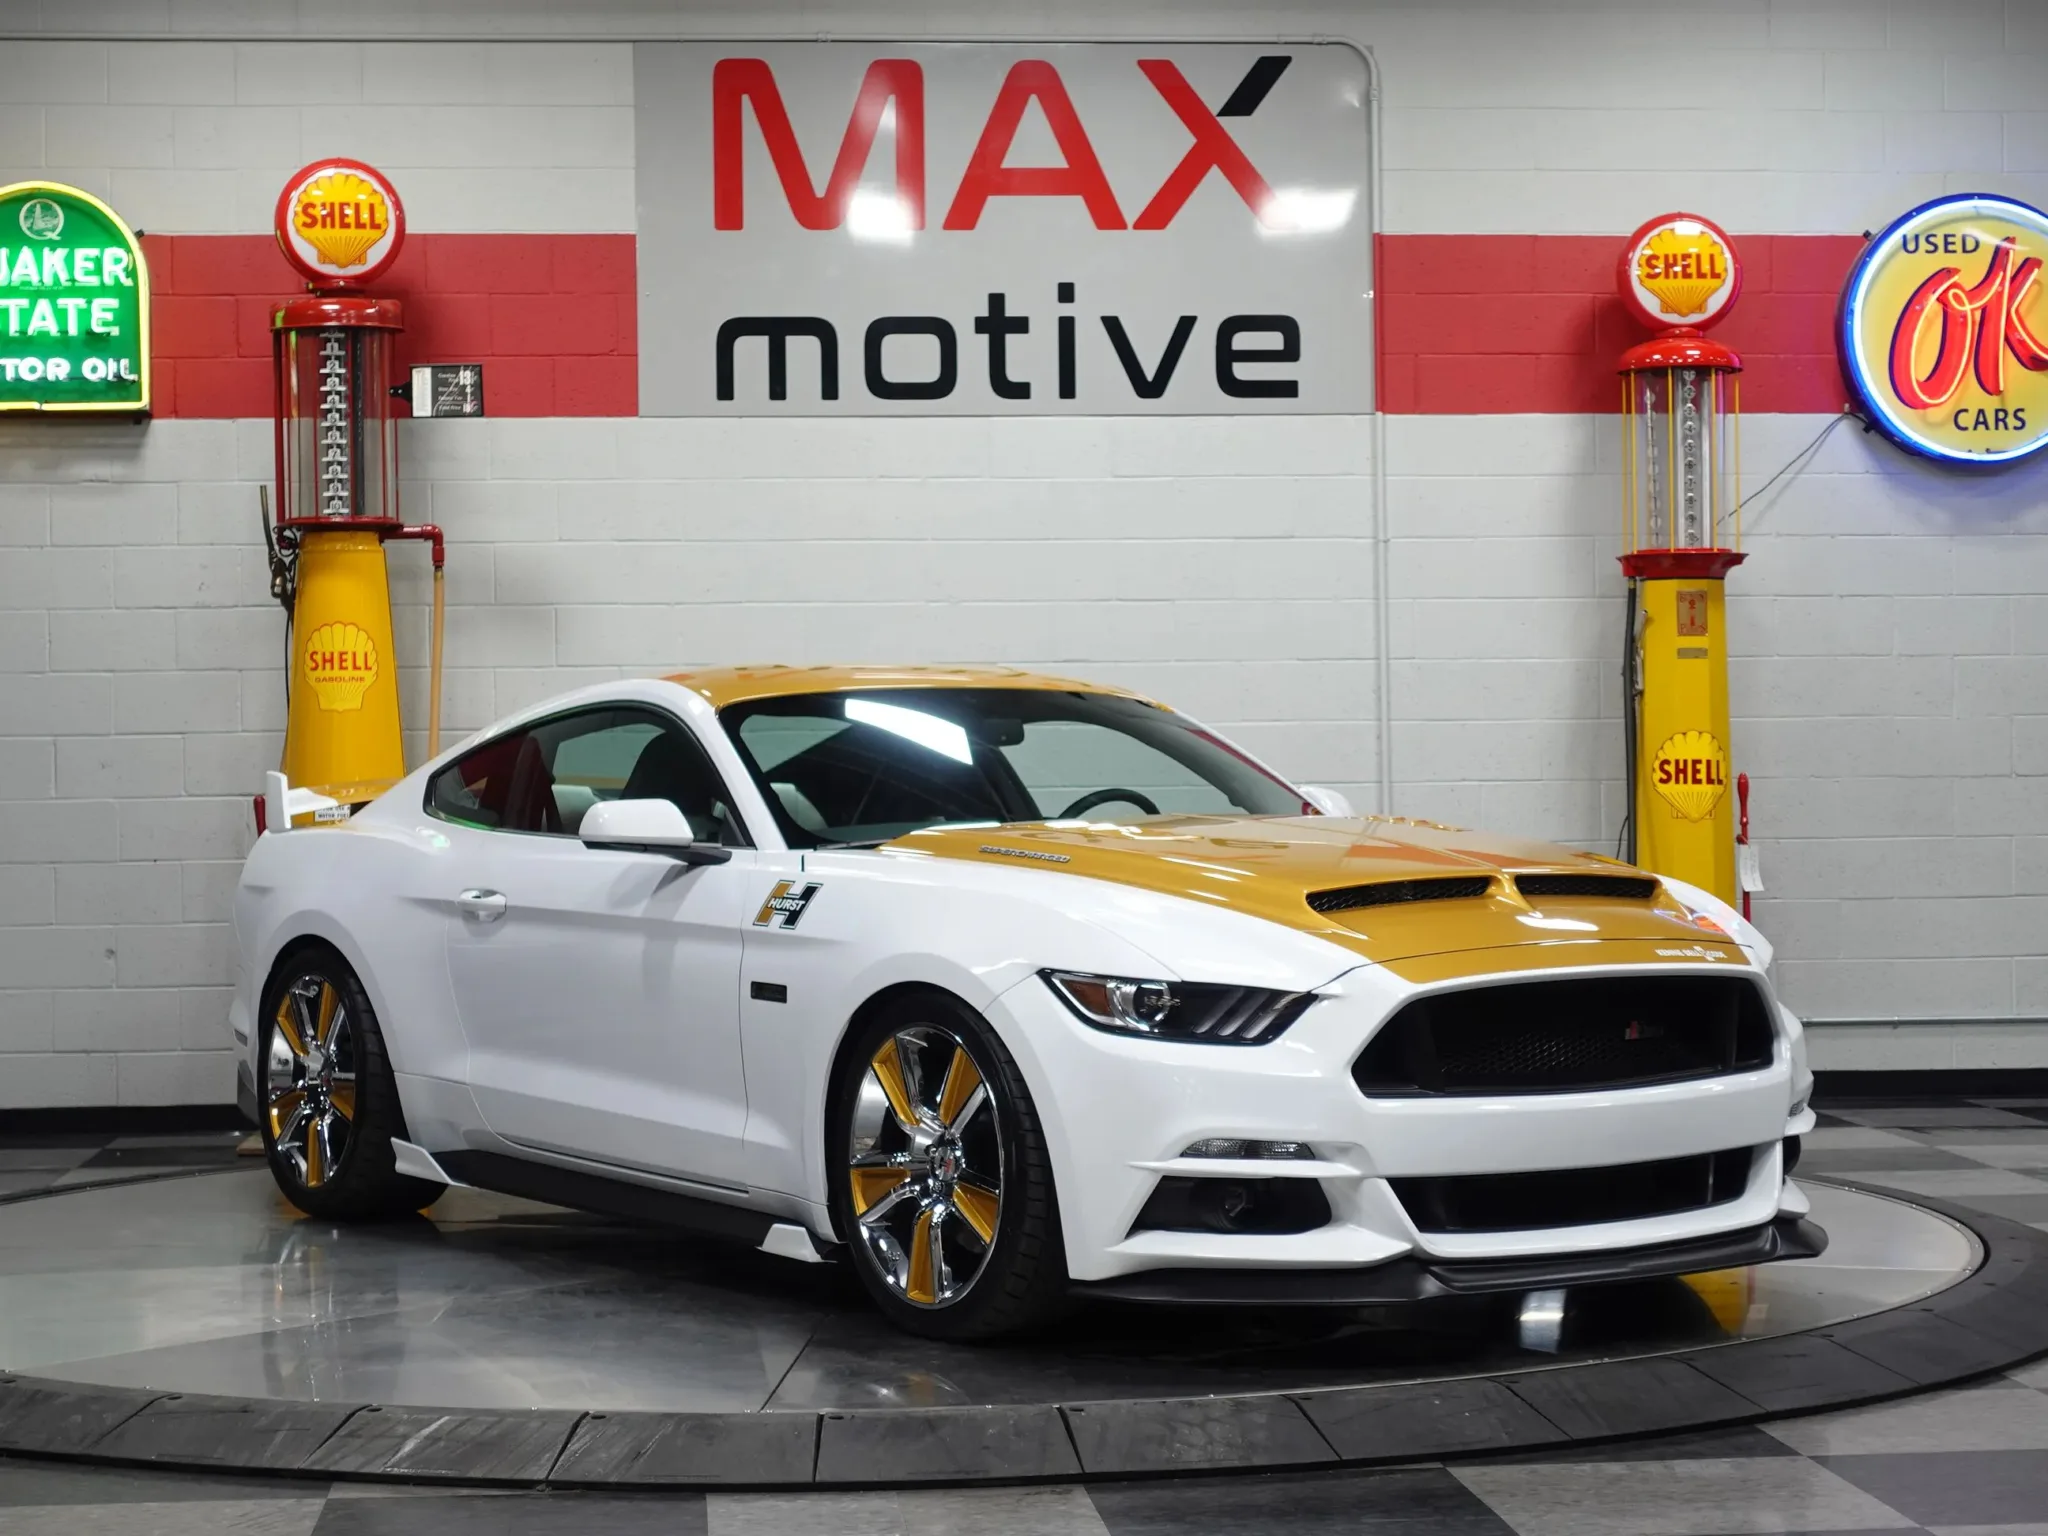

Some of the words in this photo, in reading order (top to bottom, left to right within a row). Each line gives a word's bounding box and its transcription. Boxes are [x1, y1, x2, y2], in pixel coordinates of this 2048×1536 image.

[713, 56, 1296, 230] MAX
[301, 202, 381, 230] SHELL
[1902, 233, 1980, 254] USED
[1645, 253, 1721, 280] SHELL
[716, 282, 1300, 401] motive
[82, 356, 139, 382] OIL
[1953, 408, 2026, 431] CARS
[309, 651, 373, 672] SHELL
[1658, 759, 1723, 785] SHELL
[768, 897, 805, 911] HURST
